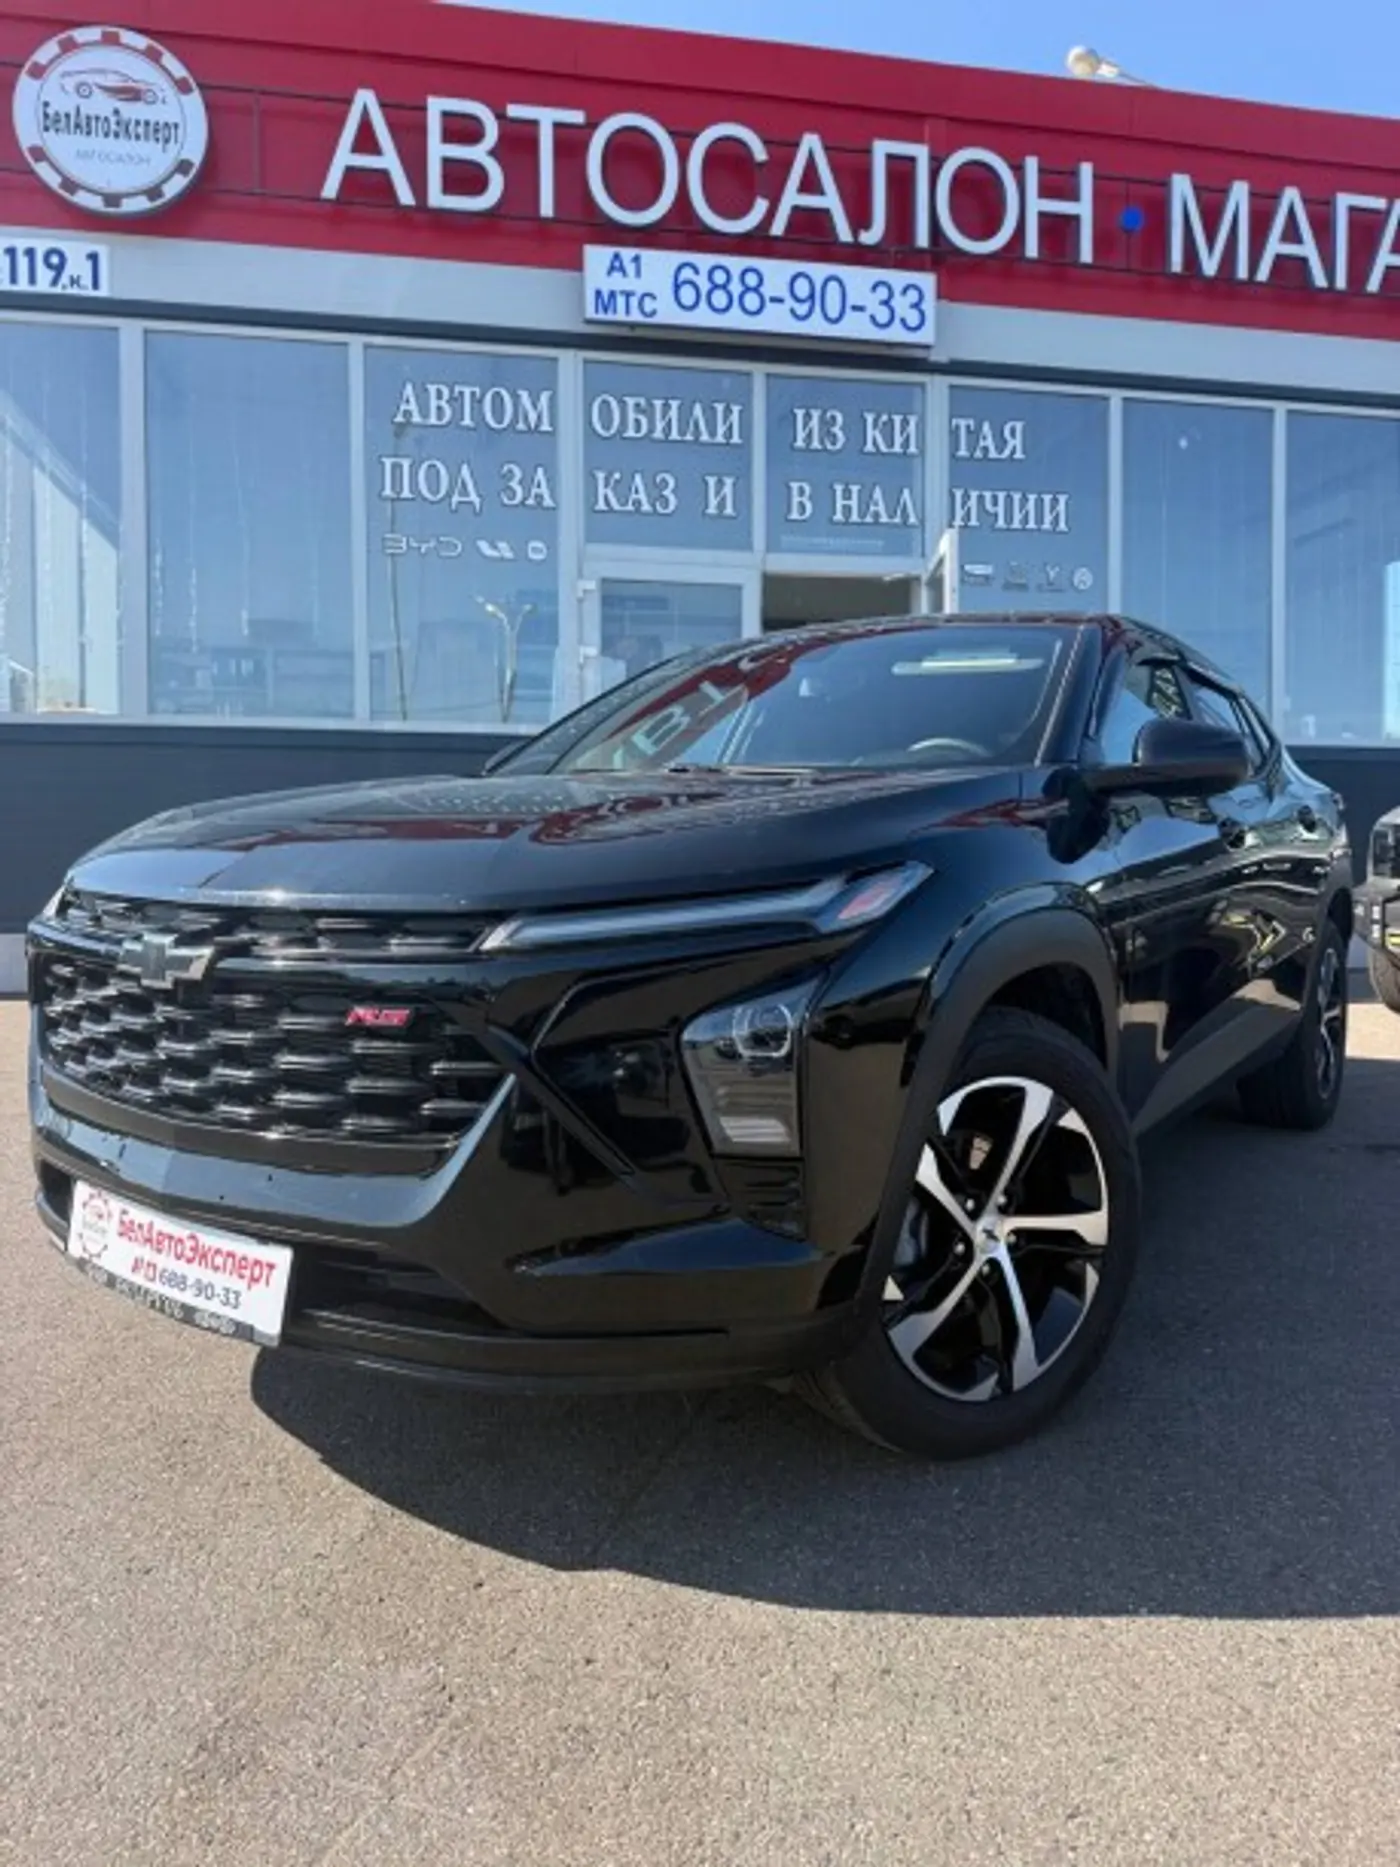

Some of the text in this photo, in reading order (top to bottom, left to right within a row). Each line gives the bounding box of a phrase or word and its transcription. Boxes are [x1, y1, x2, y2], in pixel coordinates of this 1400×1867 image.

[42, 100, 180, 152] БелАвтоЭксперт
[320, 88, 1094, 264] АВТОСАЛОН
[594, 288, 658, 319] МТС
[672, 261, 927, 333] 688-90-33
[793, 407, 846, 451] ИЗ
[380, 456, 482, 514] ПОД
[703, 475, 737, 517] И
[787, 481, 813, 522] В
[116, 1208, 277, 1291] БелАвтоЭксперт
